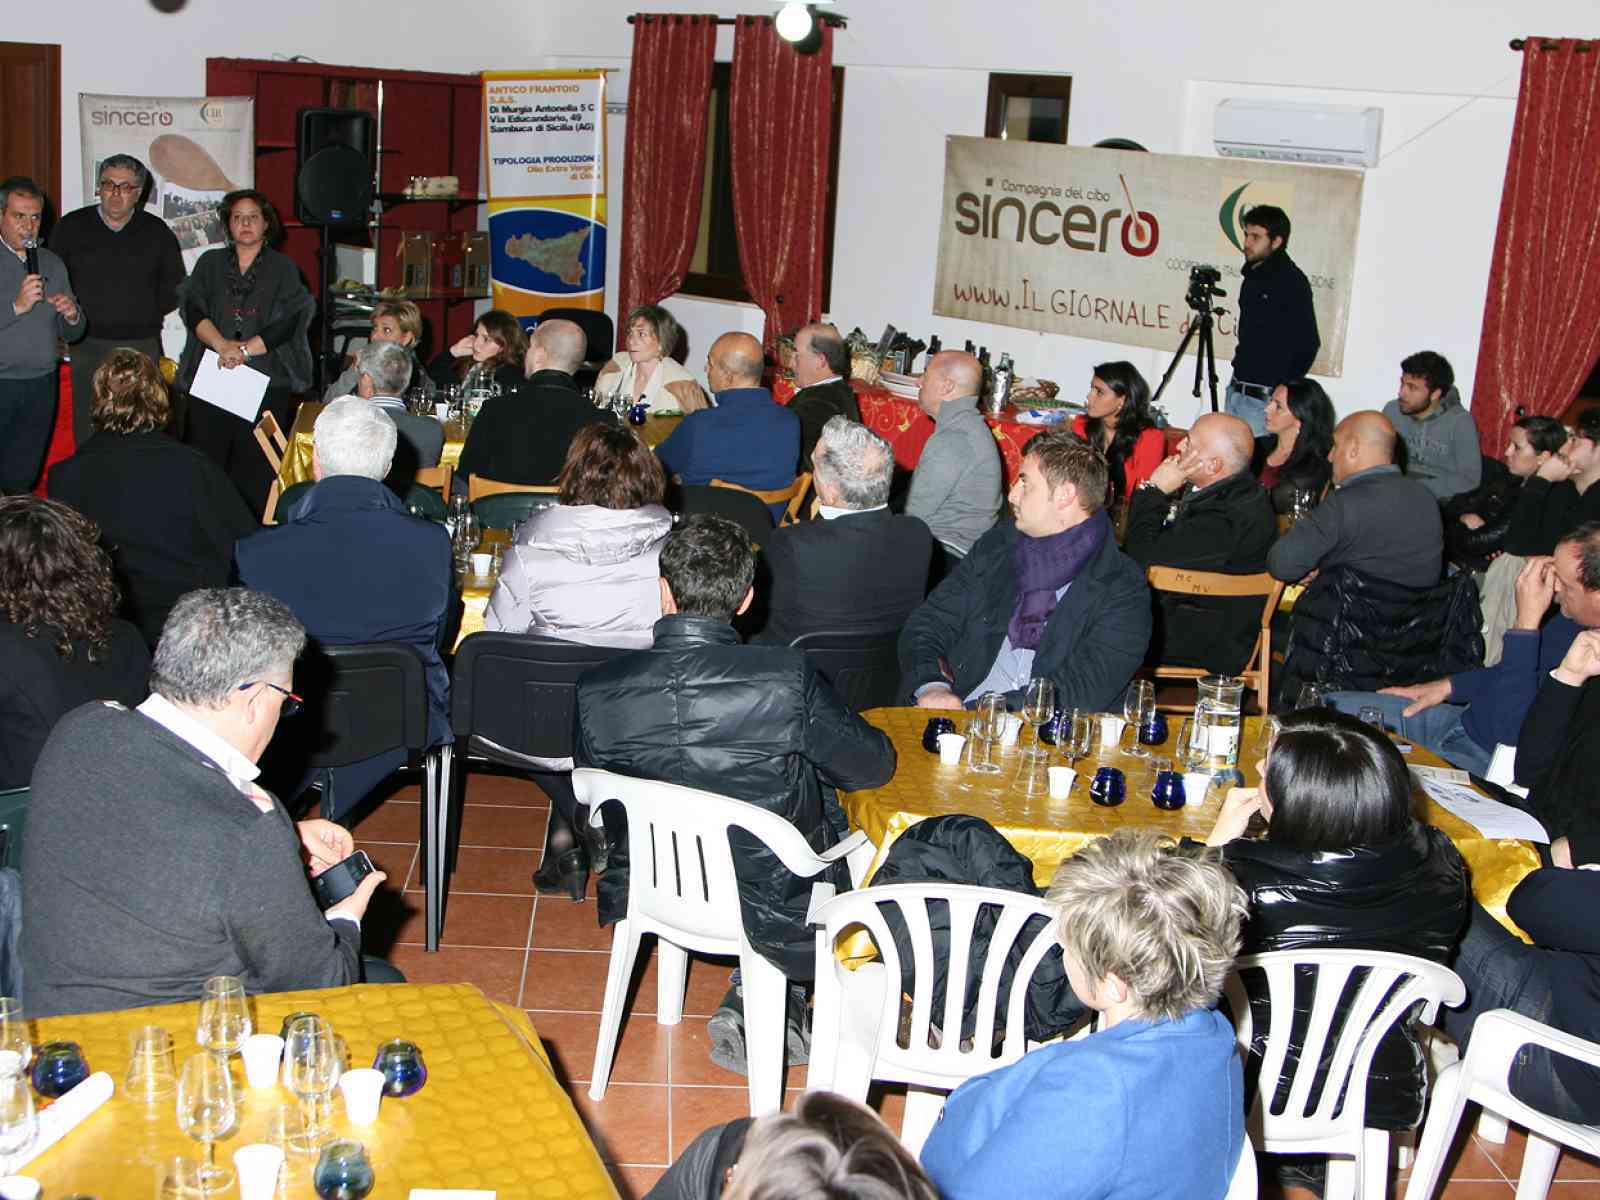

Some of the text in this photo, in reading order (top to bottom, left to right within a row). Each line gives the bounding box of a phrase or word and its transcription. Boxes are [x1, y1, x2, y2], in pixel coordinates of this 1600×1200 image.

[489, 84, 580, 95] ANTICO FRANTOIO
[489, 105, 498, 113] Di
[501, 104, 533, 115] Murgia
[535, 104, 578, 113] Antonella
[91, 105, 173, 127] sincero
[490, 115, 506, 123] Via
[490, 122, 595, 133] Sambuca di Sicilia (AG)
[493, 154, 600, 165] TIPOLOGIA PRODUZION
[545, 165, 569, 173] Extra
[1001, 178, 1112, 202] Compagnia del cibo
[955, 178, 1160, 257] sincero
[1051, 288, 1171, 329] GIORNALE
